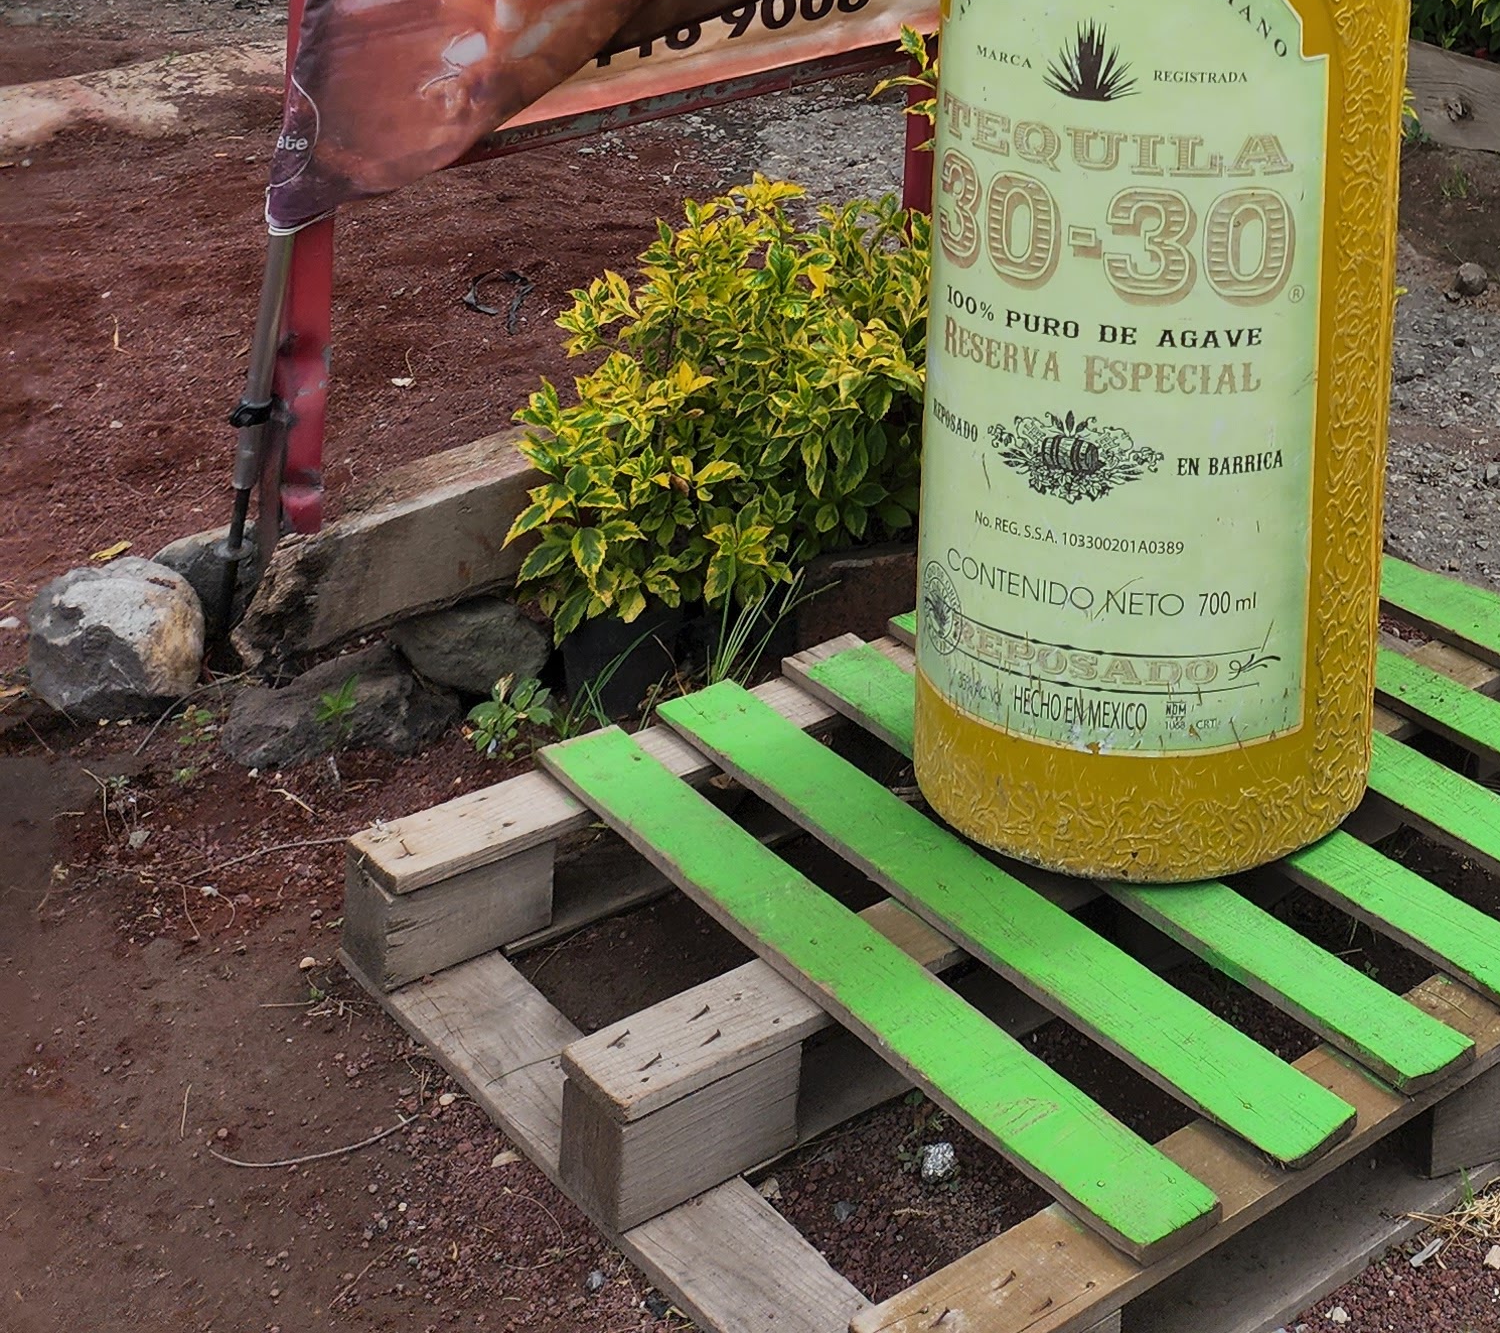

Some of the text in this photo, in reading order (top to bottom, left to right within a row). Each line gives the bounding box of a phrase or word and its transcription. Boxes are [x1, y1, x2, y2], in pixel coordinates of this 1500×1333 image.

[976, 44, 1034, 70] MARCA
[1153, 69, 1249, 85] REGISTRADA
[943, 90, 1295, 179] TEQUILA
[939, 147, 1297, 309] 30-30
[946, 284, 1263, 349] 100% PURO DE AGAVE
[944, 314, 1262, 395] RESERVA ESPECIAL
[932, 397, 979, 443] REPOSADO
[1177, 449, 1284, 477] EN BARRICA
[974, 509, 1185, 555] No. REG. S.S.A. 103300201A0389
[946, 548, 1258, 617] CONTENIDO NETO 700 ml
[959, 616, 1219, 687] REPOSADO
[1013, 684, 1062, 722] HECHO
[1065, 695, 1084, 725] EN
[1087, 699, 1148, 731] MEXICO
